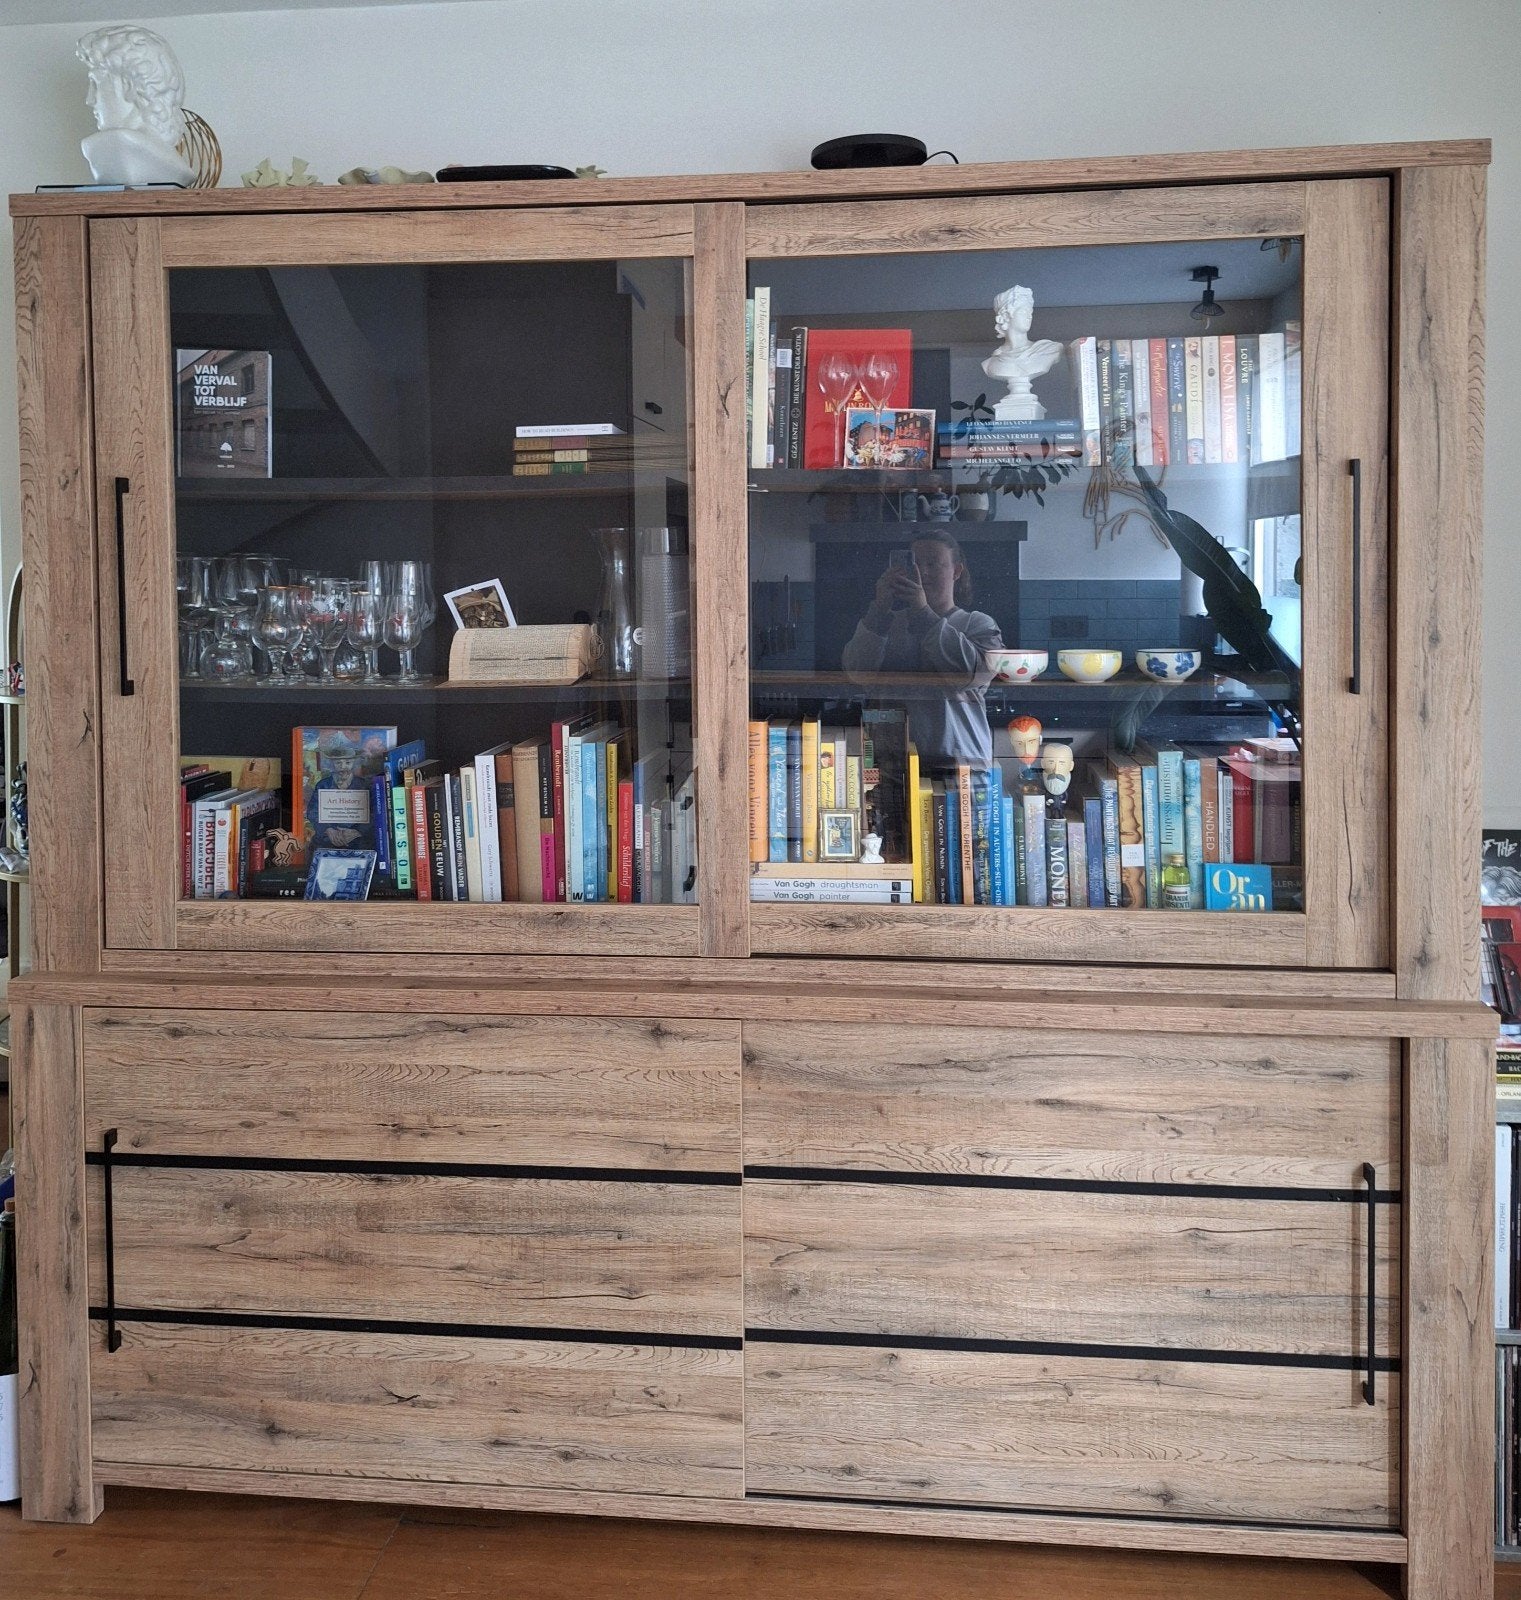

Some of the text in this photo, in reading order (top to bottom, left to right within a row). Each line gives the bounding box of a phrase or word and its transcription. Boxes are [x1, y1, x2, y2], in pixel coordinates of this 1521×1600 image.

[759, 297, 767, 309] De
[757, 309, 766, 335] Haagse
[194, 365, 218, 375] VAN
[1102, 356, 1110, 391] Vermeer's
[1118, 353, 1128, 369] The
[1223, 354, 1234, 390] MONA
[1240, 348, 1248, 384] LOUVRE
[194, 376, 237, 385] VERVAL
[1117, 373, 1128, 398] King's
[1173, 360, 1182, 390] Swerve
[194, 386, 216, 395] TOT
[194, 397, 247, 406] VERBLIJF
[1223, 395, 1235, 420] LISA
[791, 421, 799, 440] ENTZ
[554, 749, 562, 788] Rembrandt
[749, 731, 760, 840] Alles voor Vincent
[1146, 779, 1154, 789] De
[339, 797, 362, 806] History
[1146, 789, 1156, 832] geschiedenis
[395, 808, 408, 867] PICASSO
[415, 791, 425, 859] REMBRANDT'S PROMISE
[432, 812, 442, 850] GOUDEN
[454, 815, 462, 851] REMBRANDT
[963, 822, 969, 830] IN
[976, 822, 984, 839] Gogh
[994, 827, 1000, 836] IN
[1205, 801, 1215, 850] HANDLED
[1104, 788, 1118, 906] THE PAINTINGS THAT REVOLUTIONIZED ART
[1146, 832, 1155, 846] van
[1224, 828, 1232, 855] begrijpen
[435, 852, 444, 876] EEUW
[455, 853, 463, 867] MIJN
[963, 834, 971, 871] DRENTHE
[1148, 846, 1156, 858] het
[457, 868, 465, 888] VADER
[619, 845, 631, 888] Schilderslief
[1050, 846, 1066, 907] MONET
[774, 880, 879, 890] Van Gogh draughtsman
[1212, 868, 1251, 894] Or
[792, 892, 815, 901] Gogh
[819, 893, 850, 901] painter
[1231, 893, 1265, 910] an
